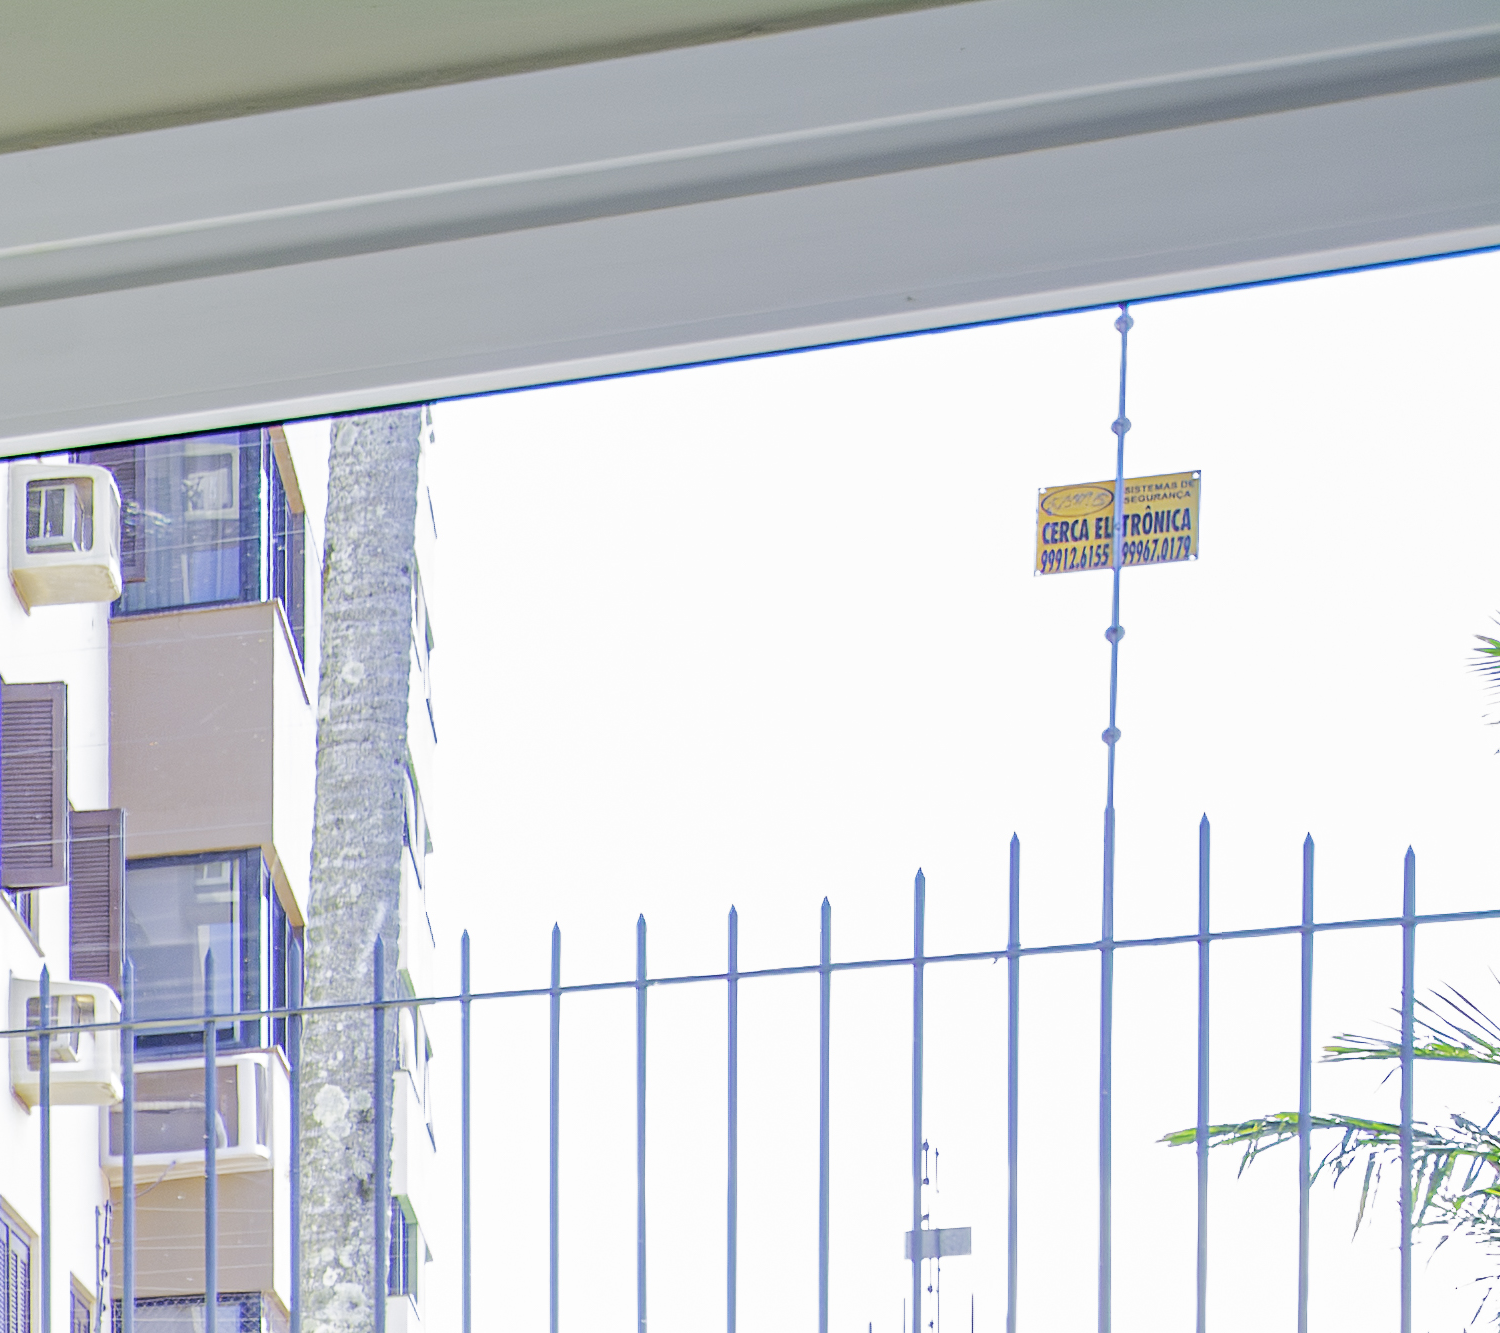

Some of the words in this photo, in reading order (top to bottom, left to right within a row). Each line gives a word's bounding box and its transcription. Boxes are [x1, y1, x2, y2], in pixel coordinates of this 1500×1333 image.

[1124, 481, 1179, 495] SISTEMAS
[1180, 479, 1196, 489] DE
[1124, 490, 1192, 504] SEGURANÇA
[1042, 518, 1089, 545] CERCA
[1094, 505, 1192, 540] ELTRÔNICA
[1040, 543, 1110, 573] 99912.6155
